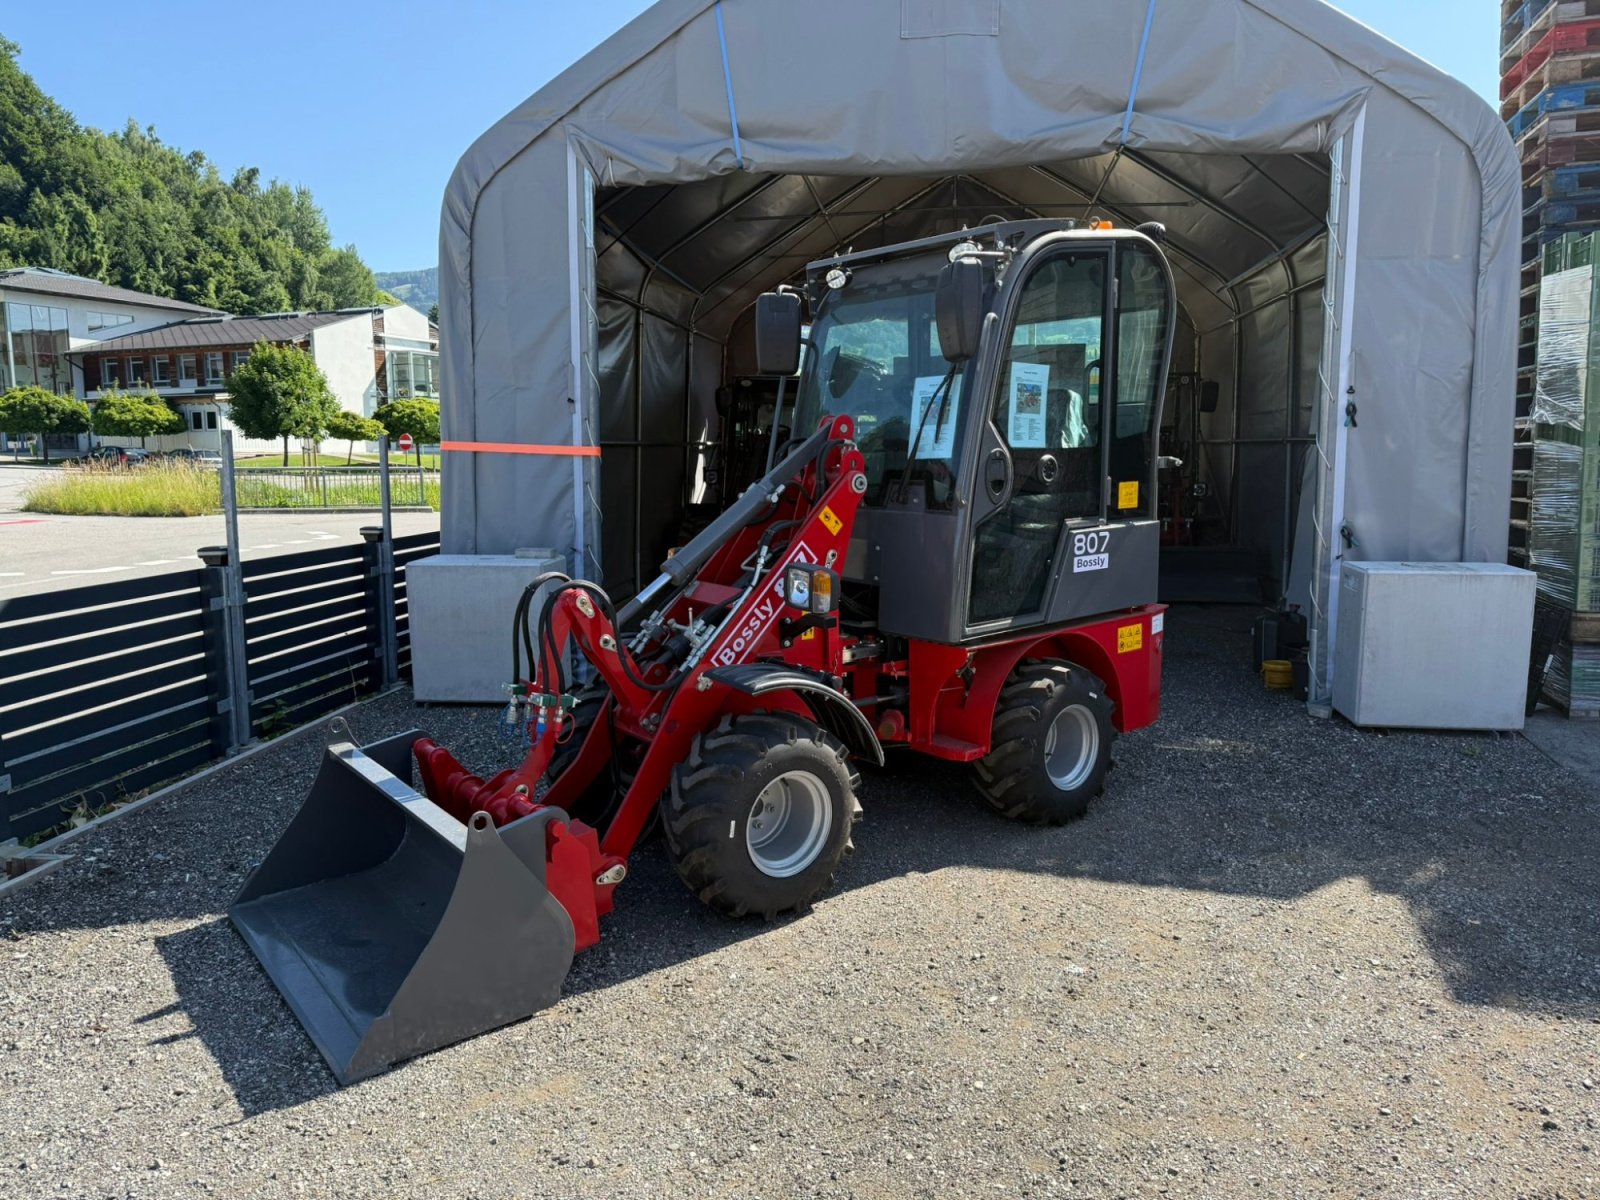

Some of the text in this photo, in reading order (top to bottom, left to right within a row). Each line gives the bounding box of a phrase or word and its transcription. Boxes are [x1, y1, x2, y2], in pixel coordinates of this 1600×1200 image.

[1074, 531, 1110, 555] 807
[1076, 556, 1106, 568] Bossly
[719, 597, 774, 666] Bossly
